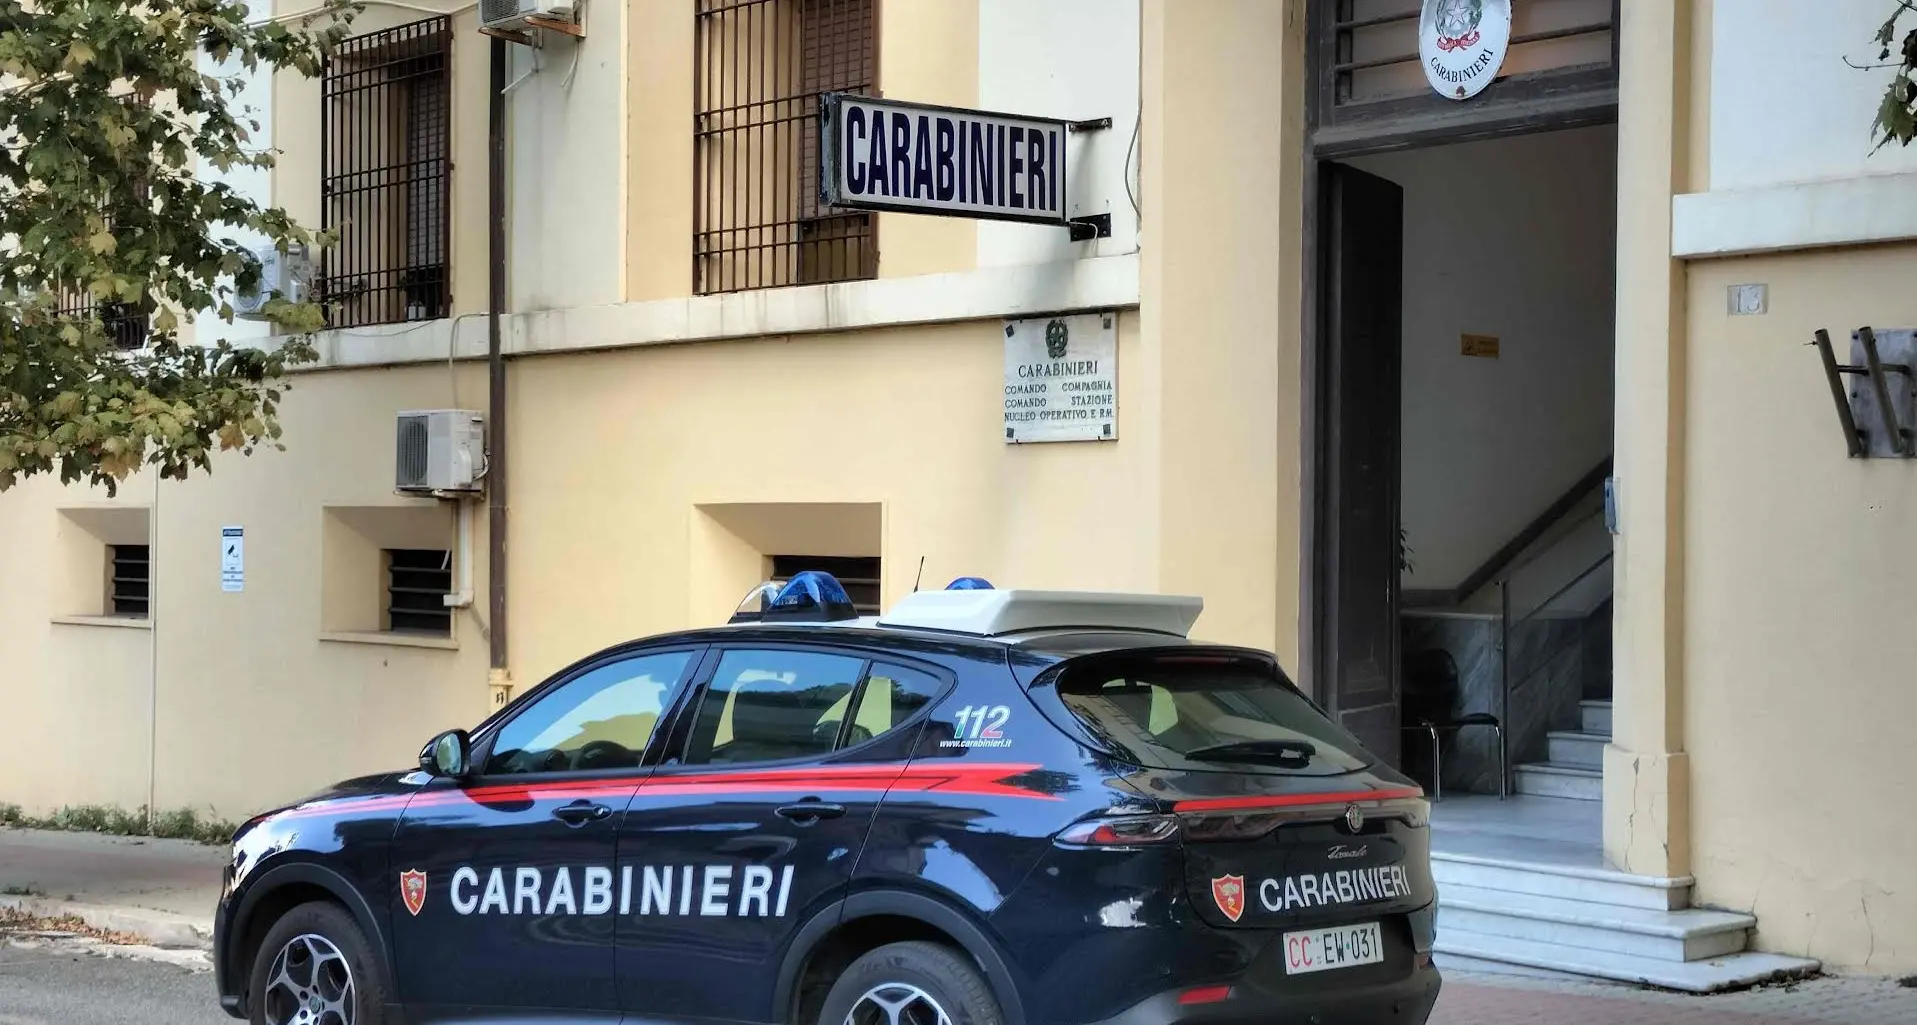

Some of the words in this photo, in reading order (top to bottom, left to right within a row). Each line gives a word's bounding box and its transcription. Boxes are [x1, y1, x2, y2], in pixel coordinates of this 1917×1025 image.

[1430, 48, 1494, 83] CARABINIERI
[846, 106, 1057, 212] CARABINIERI
[1018, 361, 1098, 378] CARABINIERI
[1004, 383, 1047, 395] COMANDO
[1061, 380, 1113, 392] COMPAGNIA
[1004, 398, 1047, 409] COMANDO
[1071, 394, 1113, 406] STAZIONE
[1004, 411, 1036, 422] NUCLEO
[1040, 409, 1087, 421] OPERATIVO
[1090, 408, 1096, 419] E
[953, 704, 1011, 739] 112
[939, 738, 1013, 748] www.carabinieri.it
[450, 865, 794, 917] CARABINIERI
[1259, 865, 1411, 912] CARABINIERI
[1288, 936, 1313, 968] CC
